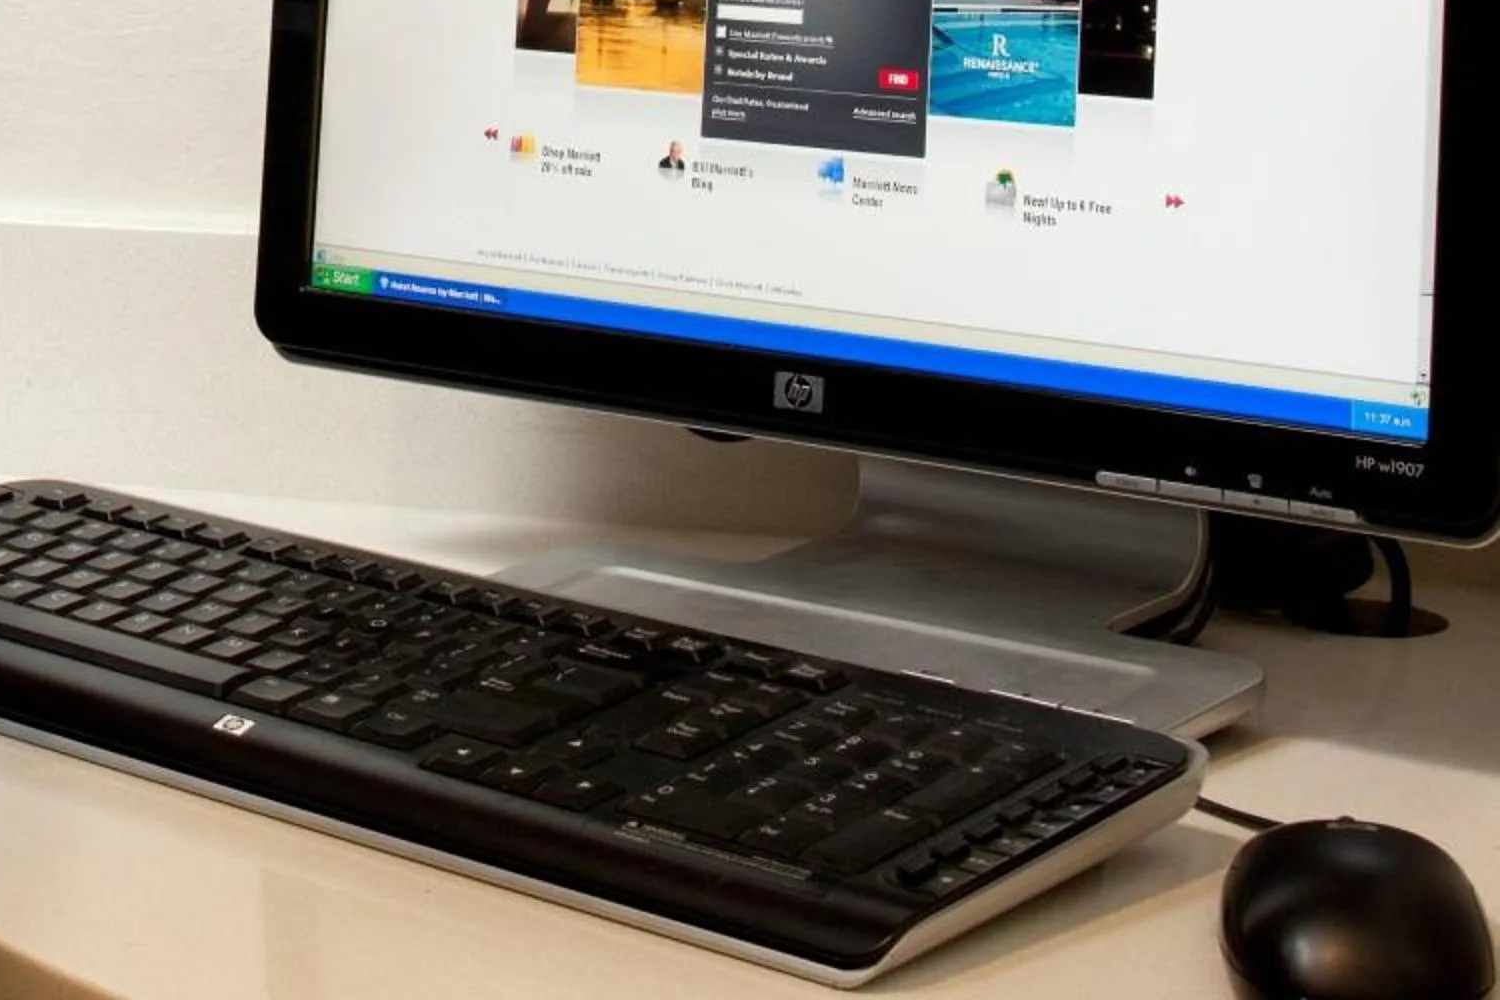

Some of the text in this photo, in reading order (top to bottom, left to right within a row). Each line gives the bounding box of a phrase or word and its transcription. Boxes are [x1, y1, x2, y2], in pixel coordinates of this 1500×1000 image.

[991, 33, 1011, 57] R
[888, 73, 909, 85] FIND
[852, 176, 890, 192] Marriott
[1049, 196, 1065, 213] Up
[1066, 199, 1077, 211] to
[1088, 200, 1113, 215] Free
[1022, 211, 1057, 227] Nights
[1355, 455, 1376, 471] HP
